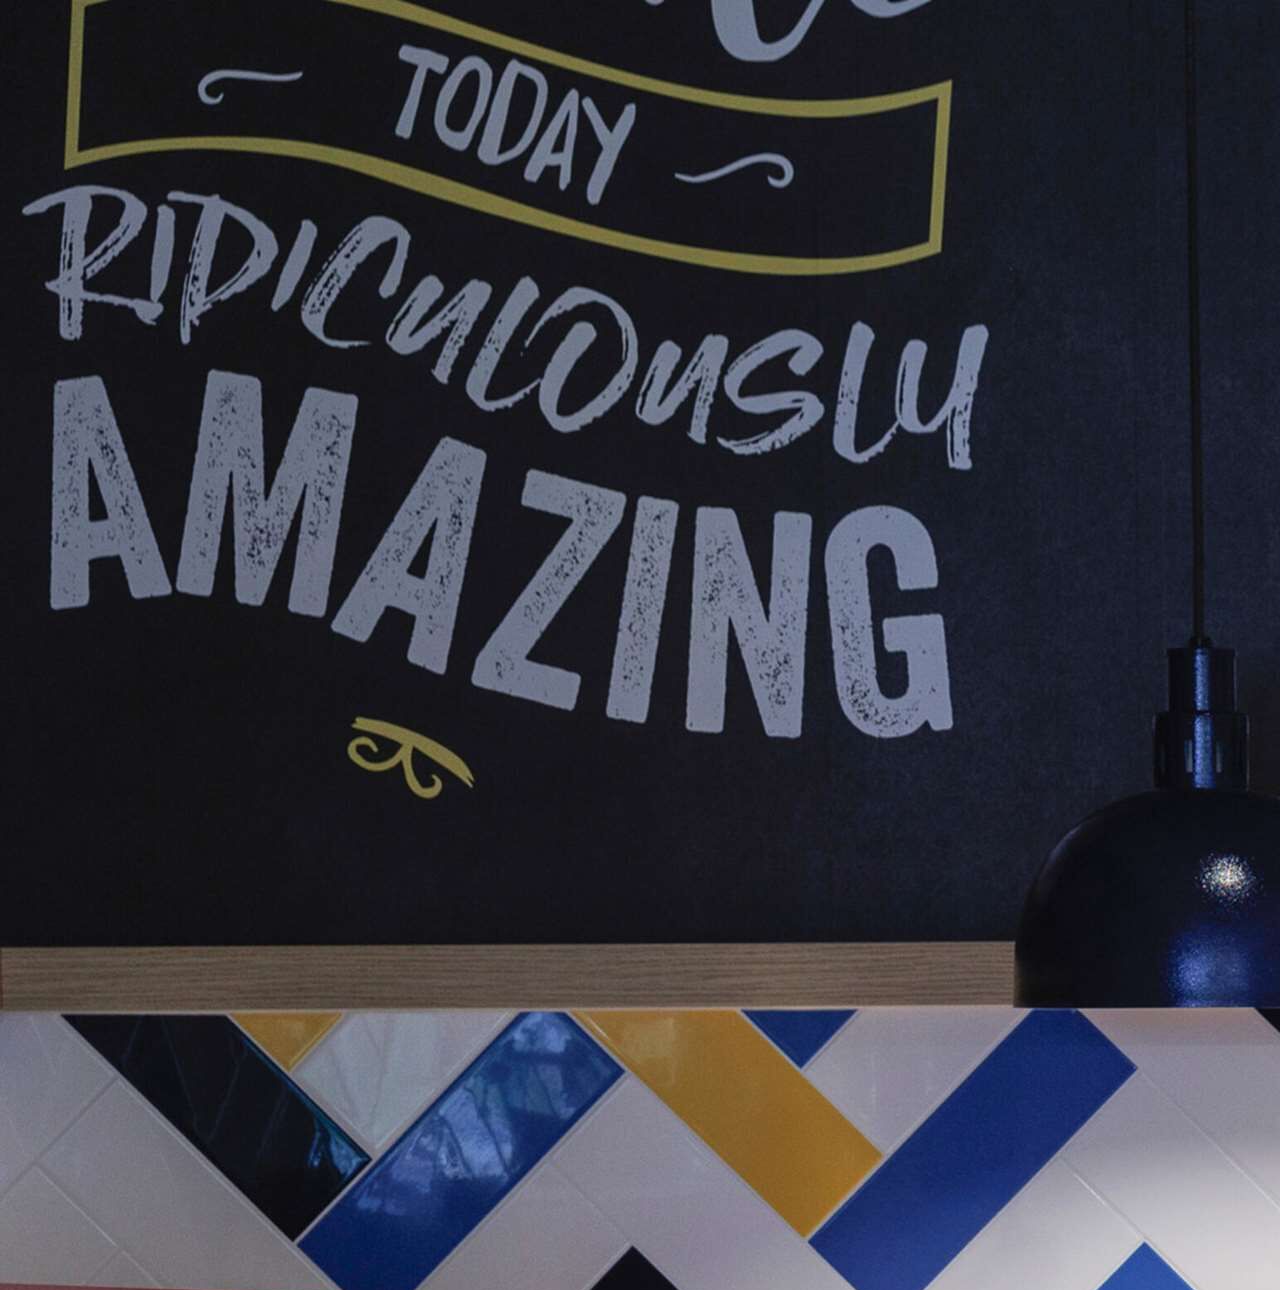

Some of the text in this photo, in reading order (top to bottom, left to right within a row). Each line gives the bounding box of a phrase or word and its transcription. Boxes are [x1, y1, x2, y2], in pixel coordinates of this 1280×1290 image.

[396, 45, 636, 205] TODAY
[22, 185, 990, 470] RIDICULOUSLY
[50, 369, 953, 739] AMAZING
